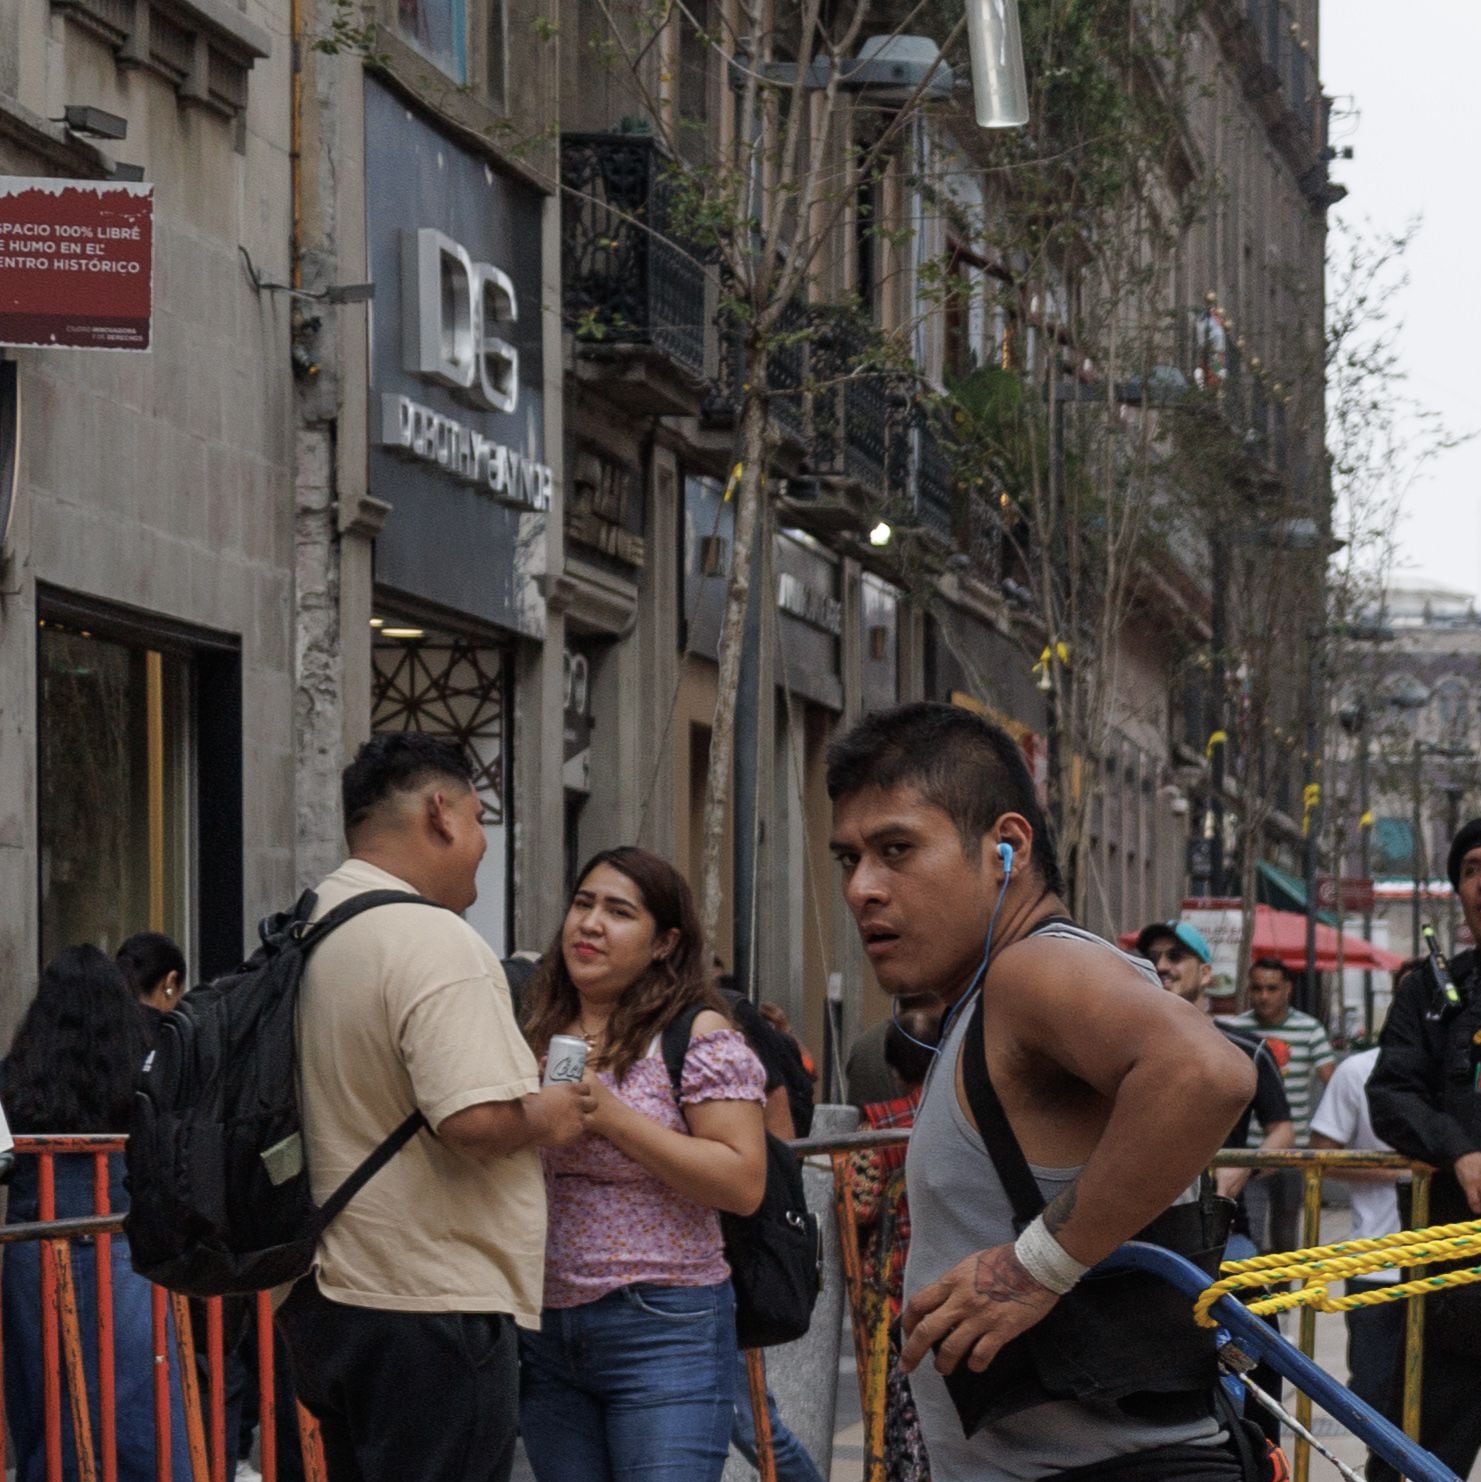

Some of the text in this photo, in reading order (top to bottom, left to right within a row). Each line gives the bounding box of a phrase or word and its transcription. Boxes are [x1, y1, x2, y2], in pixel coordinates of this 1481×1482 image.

[54, 225, 94, 238] 100%
[9, 241, 56, 253] HUMO
[60, 242, 82, 255] EN
[86, 243, 106, 256] EL
[53, 258, 140, 273] HISTÓRICO
[403, 228, 518, 413] DG
